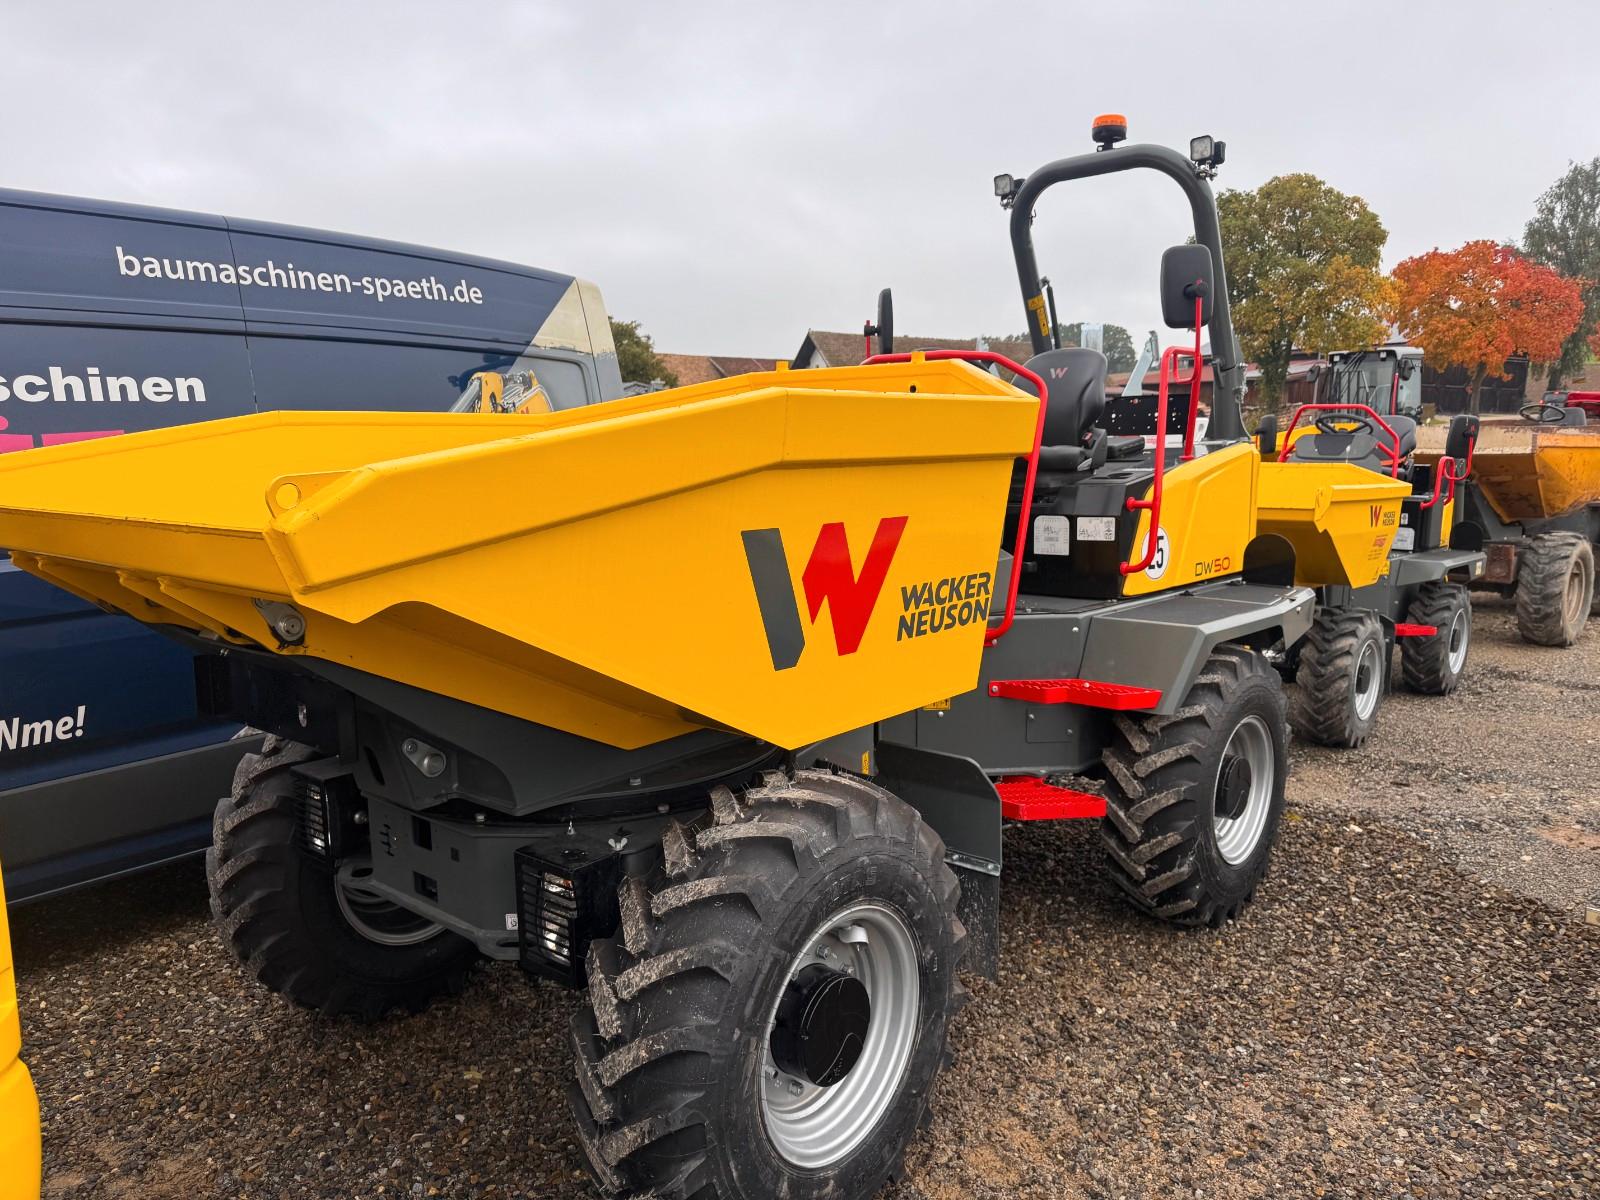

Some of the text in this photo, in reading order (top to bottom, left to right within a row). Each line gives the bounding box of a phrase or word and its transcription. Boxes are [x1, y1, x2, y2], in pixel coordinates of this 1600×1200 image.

[115, 246, 483, 305] baumaschinen-spaeth.de
[1194, 556, 1231, 577] DW50
[900, 571, 991, 612] WACKER
[896, 597, 990, 642] NEUSON
